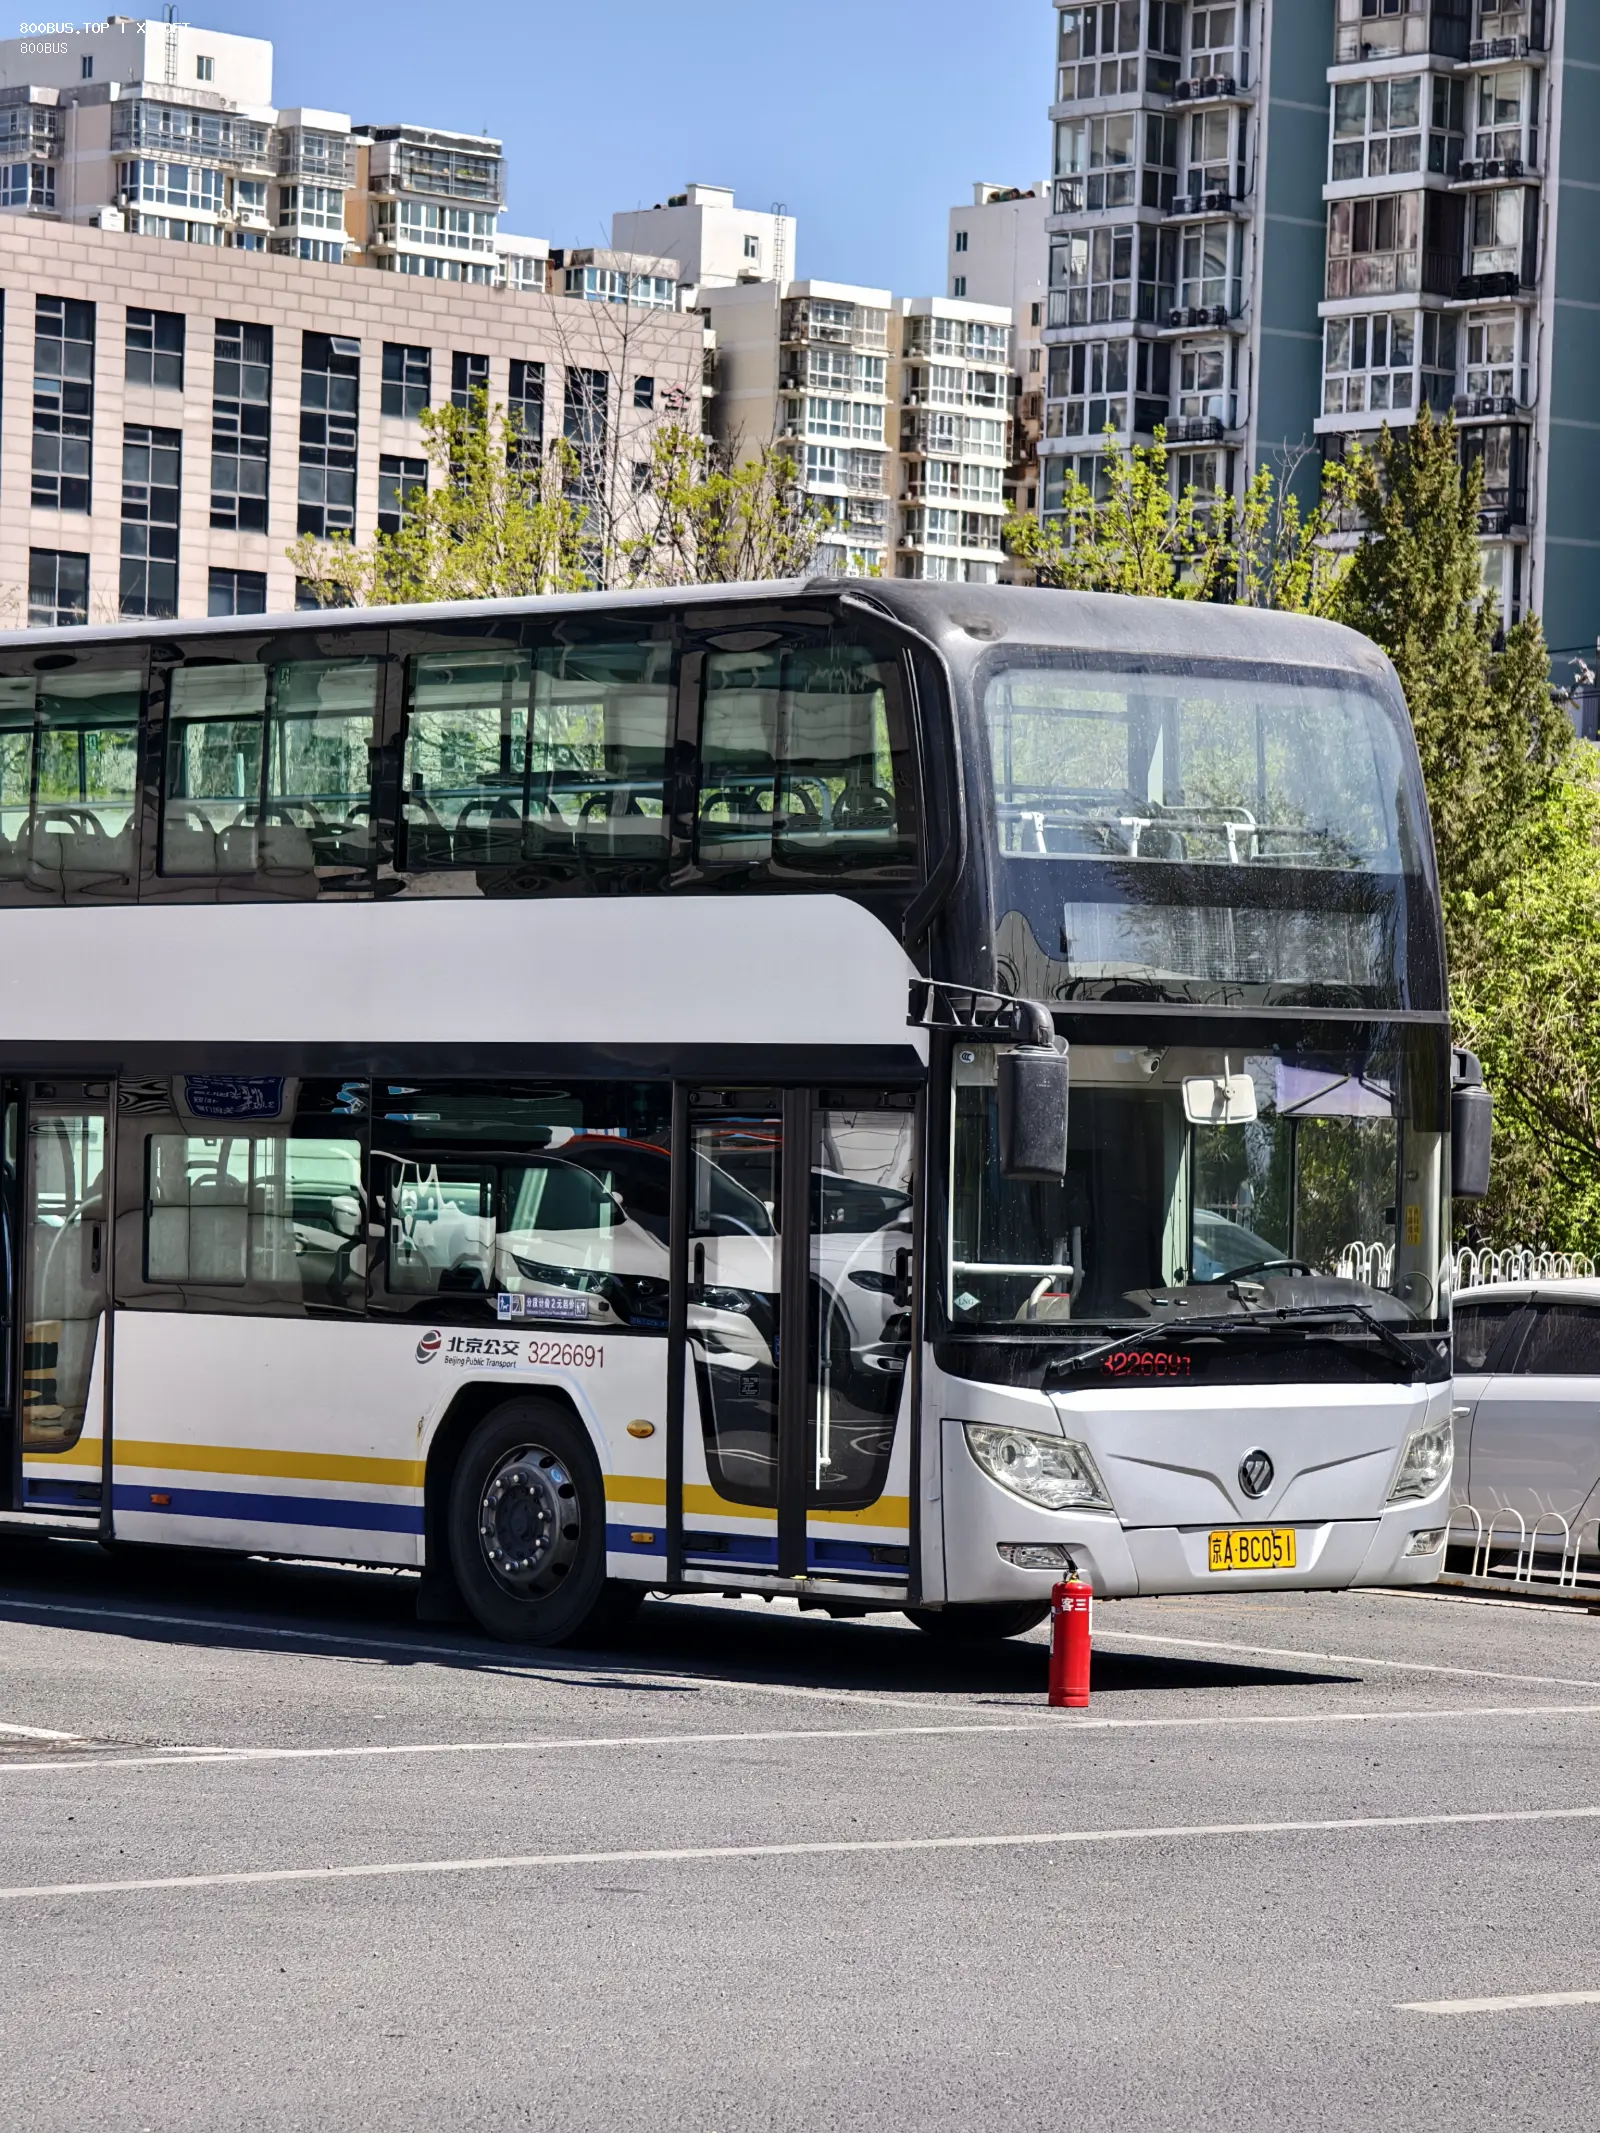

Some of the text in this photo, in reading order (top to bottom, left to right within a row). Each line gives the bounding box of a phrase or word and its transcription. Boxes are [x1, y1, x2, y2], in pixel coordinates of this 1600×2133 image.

[446, 1337, 520, 1356] 北京公交
[528, 1341, 604, 1368] 3226691
[444, 1355, 516, 1369] Beijing Public Transport
